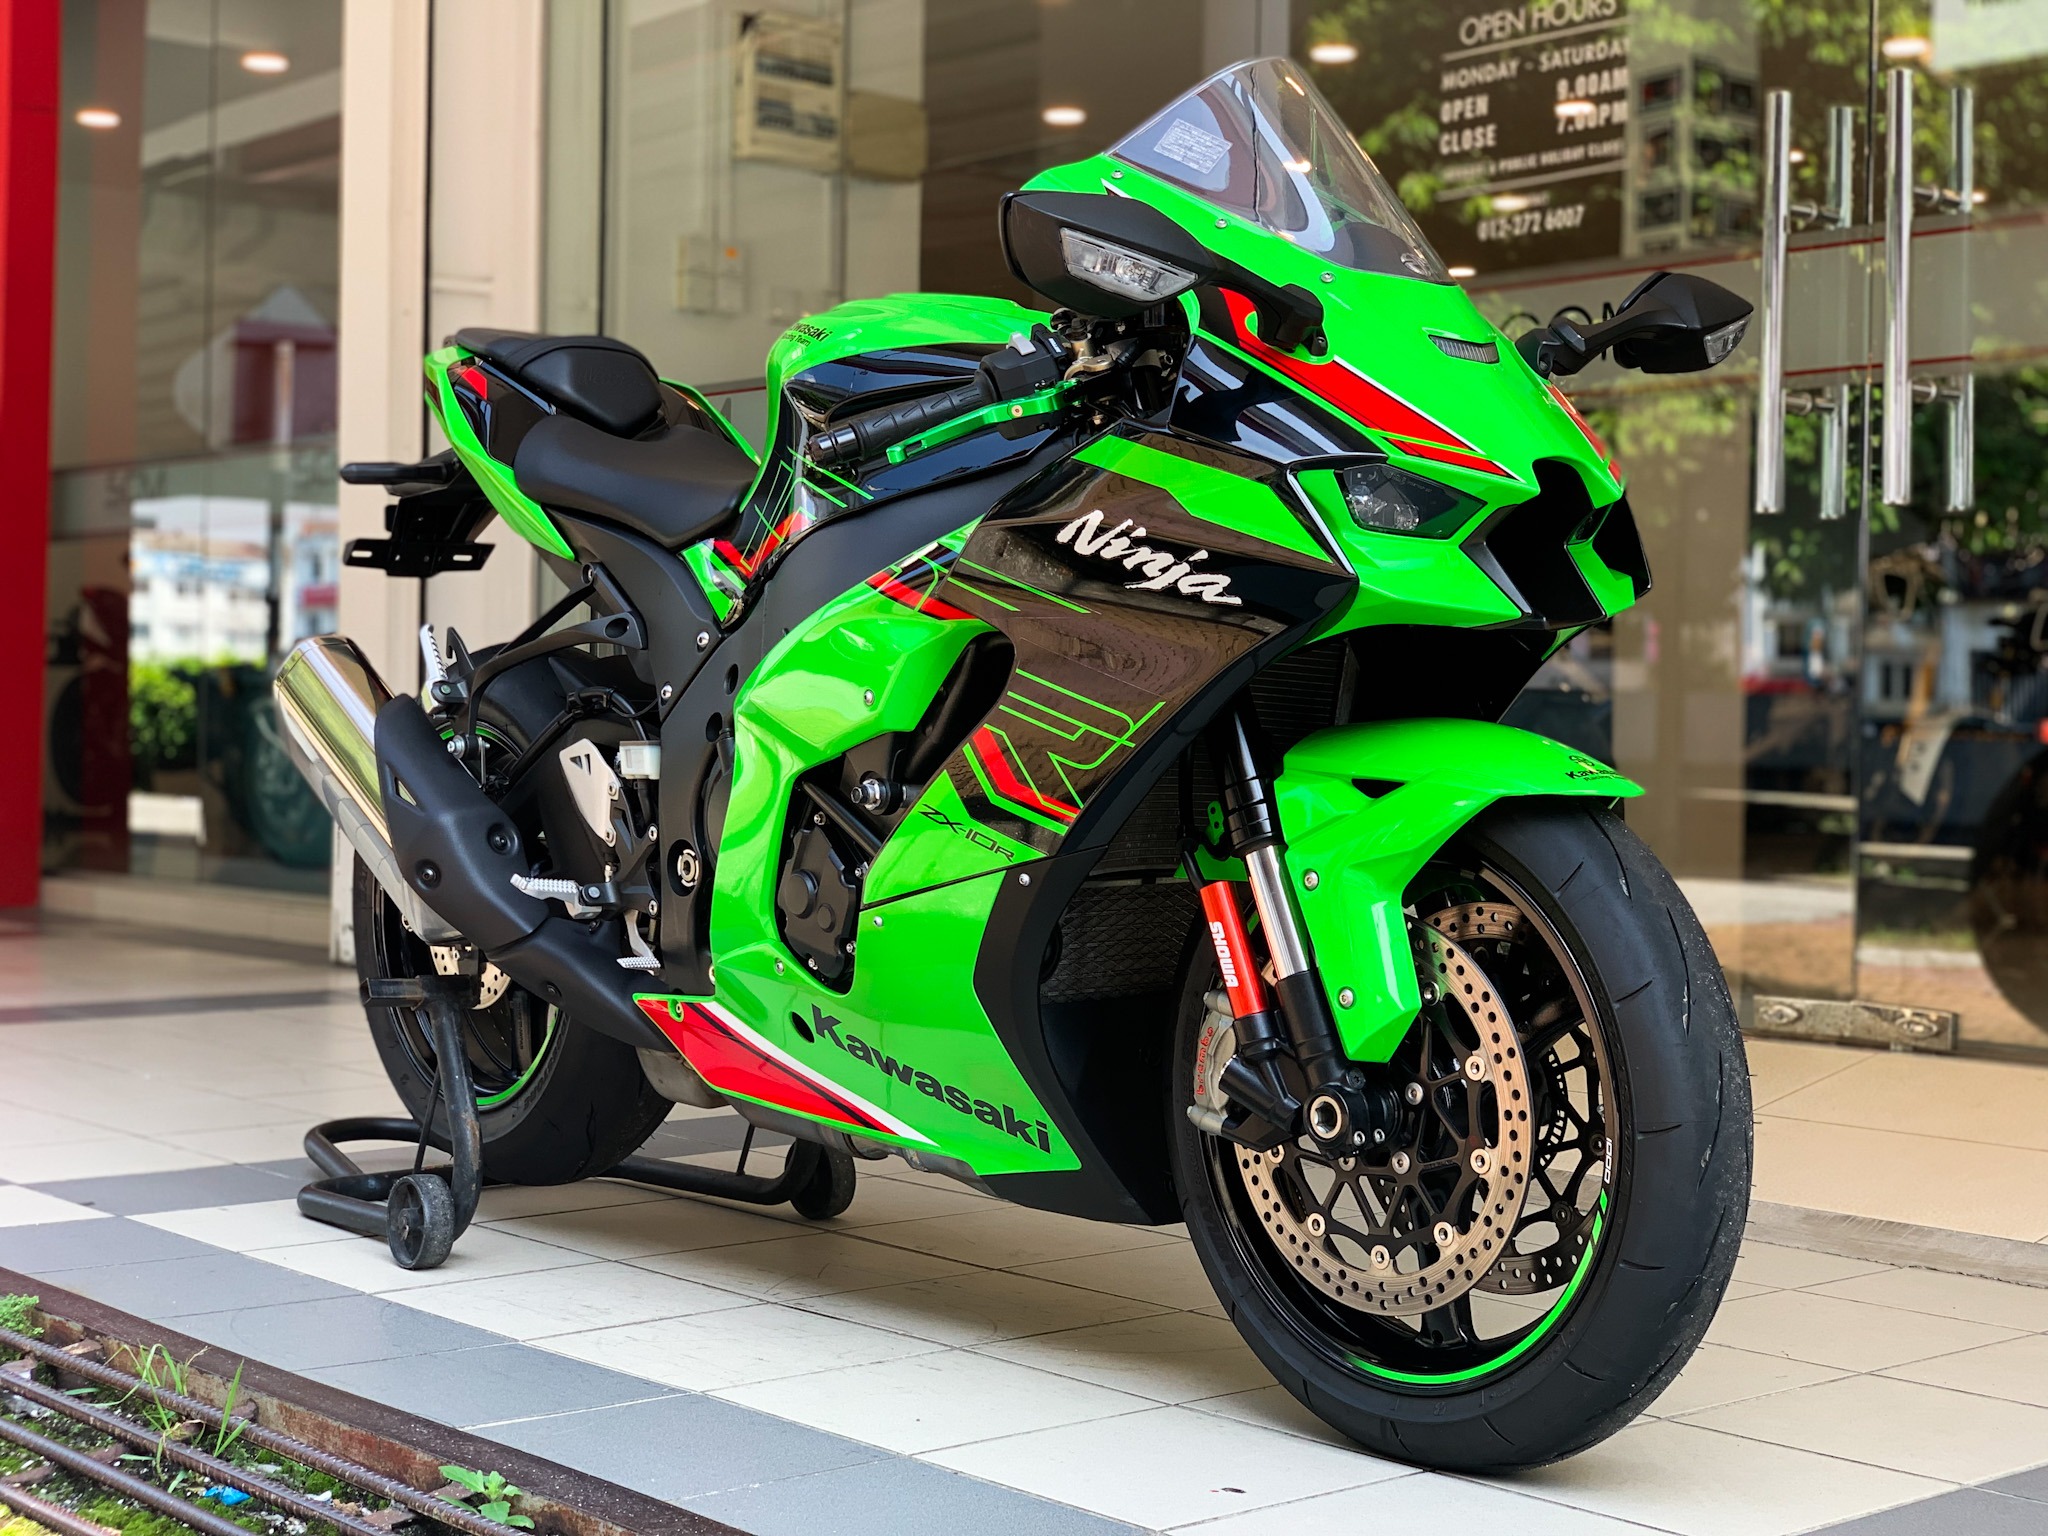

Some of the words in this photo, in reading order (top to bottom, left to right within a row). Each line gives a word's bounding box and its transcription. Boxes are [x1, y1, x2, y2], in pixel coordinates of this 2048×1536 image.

[1459, 6, 1526, 46] OPEN
[1531, 0, 1617, 31] HOURS
[1440, 58, 1519, 91] MONDAY
[1538, 37, 1629, 72] SATURDAY
[1440, 94, 1489, 124] OPEN
[1439, 124, 1498, 155] CLOSE
[1056, 509, 1243, 606] Ninja
[917, 803, 1015, 864] ZX-10R
[1208, 921, 1239, 988] SHOWA
[811, 1003, 1051, 1155] Kawasaki
[1196, 1026, 1214, 1096] brembo
[1604, 1137, 1613, 1185] 1000
